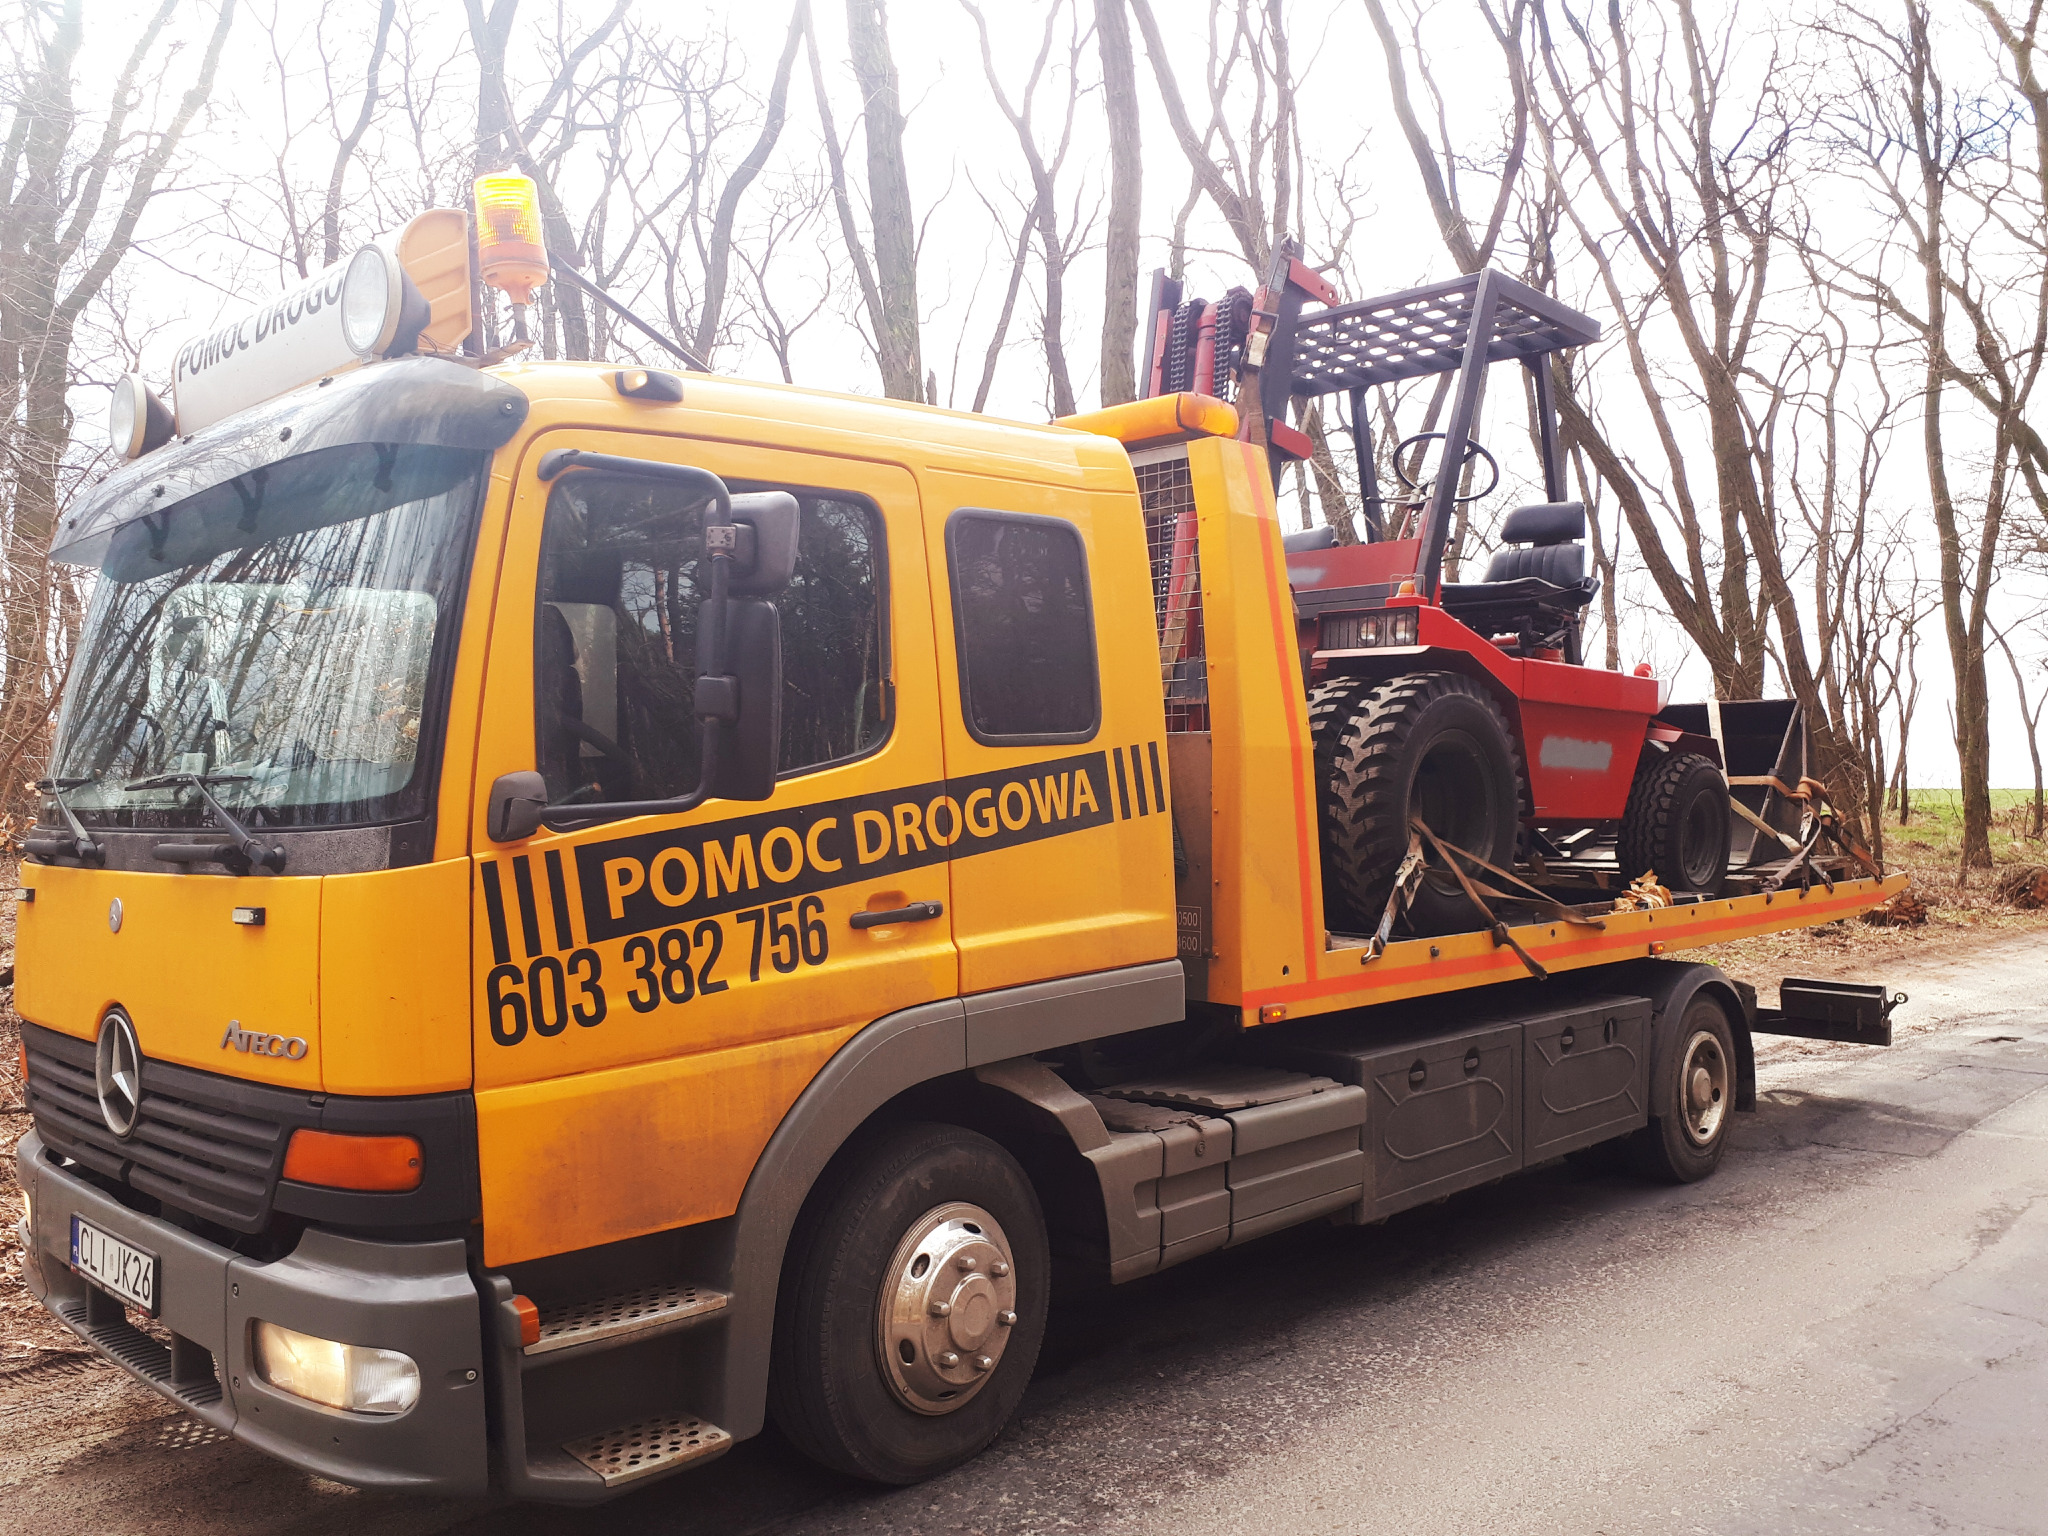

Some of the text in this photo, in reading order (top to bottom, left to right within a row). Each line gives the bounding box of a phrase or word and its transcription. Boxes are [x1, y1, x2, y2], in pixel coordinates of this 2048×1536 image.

[178, 266, 345, 382] POMOC DROGO
[603, 768, 1099, 920] POMOC DROGOWA
[486, 895, 829, 1046] 603 382 756
[80, 1227, 105, 1276] CLI
[114, 1246, 151, 1301] JK26
